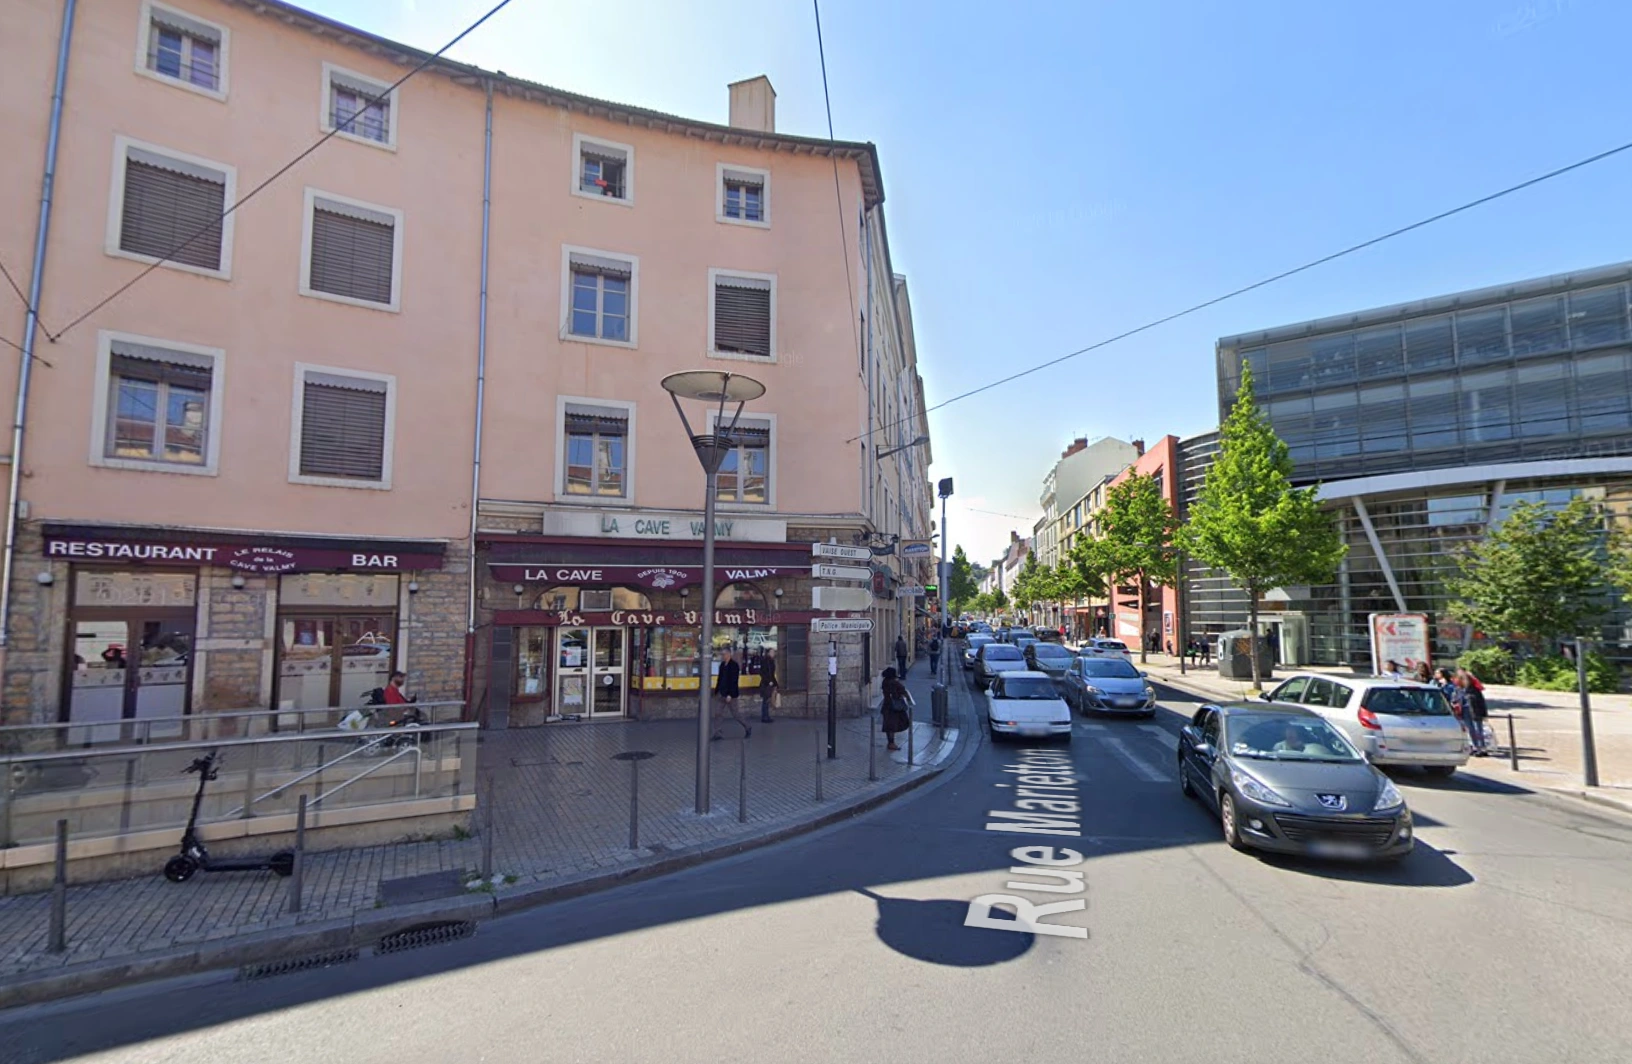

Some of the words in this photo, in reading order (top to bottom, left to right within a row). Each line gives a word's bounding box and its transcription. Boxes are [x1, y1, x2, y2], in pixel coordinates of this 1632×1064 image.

[601, 513, 619, 533] LA
[635, 519, 670, 535] CAVE
[49, 541, 217, 560] RESTAURANT
[234, 549, 249, 557] LE
[252, 547, 294, 558] RELAIS
[822, 547, 838, 555] VAISE
[840, 548, 857, 557] OUEST
[230, 560, 258, 571] CAVE
[262, 562, 296, 571] VALMY
[352, 554, 398, 567] BAR
[525, 569, 548, 580] LA
[556, 569, 603, 581] CAVE
[637, 568, 666, 579] DEPUIS
[669, 569, 687, 579] 1900
[725, 568, 777, 580] VALMY
[611, 610, 666, 626] Cave
